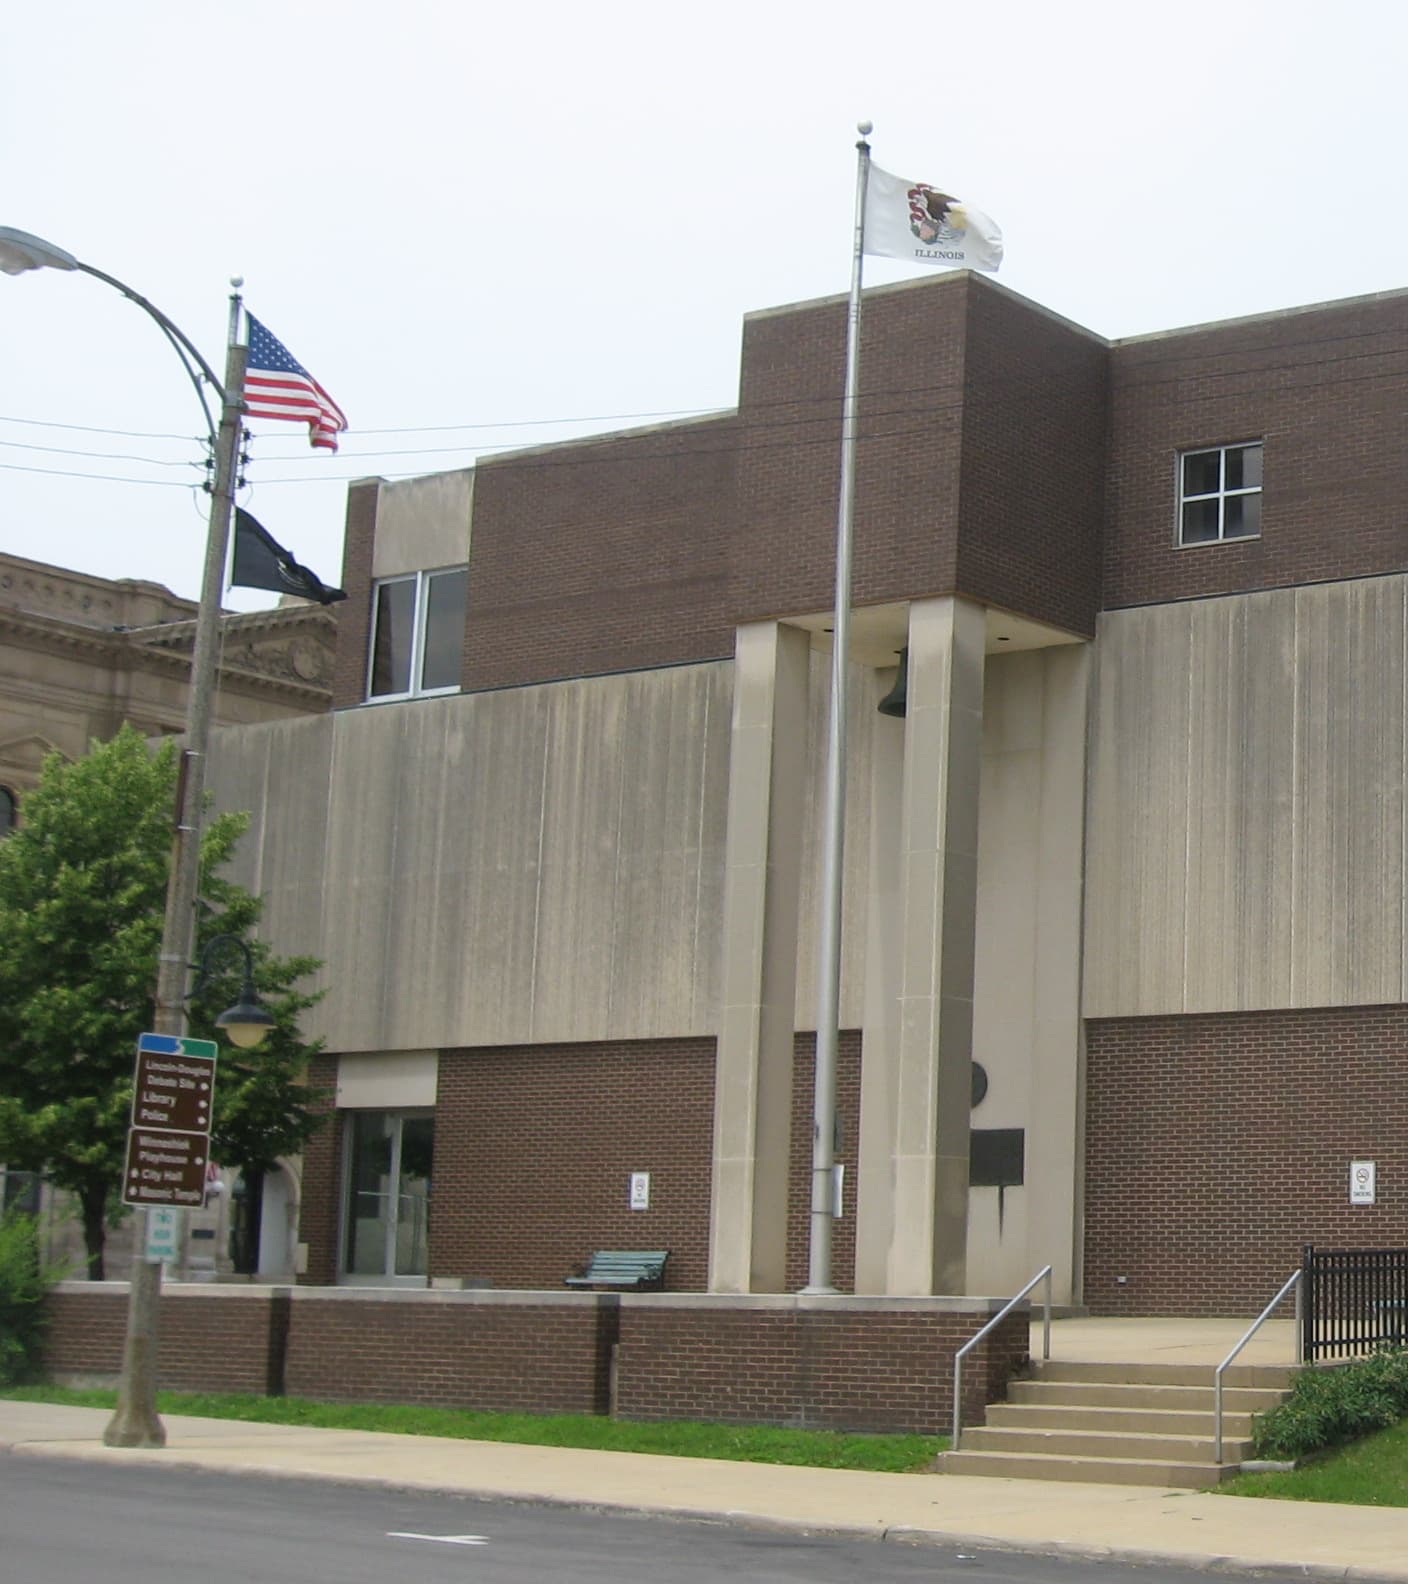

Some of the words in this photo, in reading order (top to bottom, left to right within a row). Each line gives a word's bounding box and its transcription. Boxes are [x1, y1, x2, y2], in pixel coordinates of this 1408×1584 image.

[915, 249, 965, 260] ILLINOIS
[179, 1078, 196, 1089] Site
[143, 1091, 176, 1107] Library
[141, 1109, 169, 1122] Police
[142, 1169, 161, 1182] City
[164, 1171, 183, 1182] Hall
